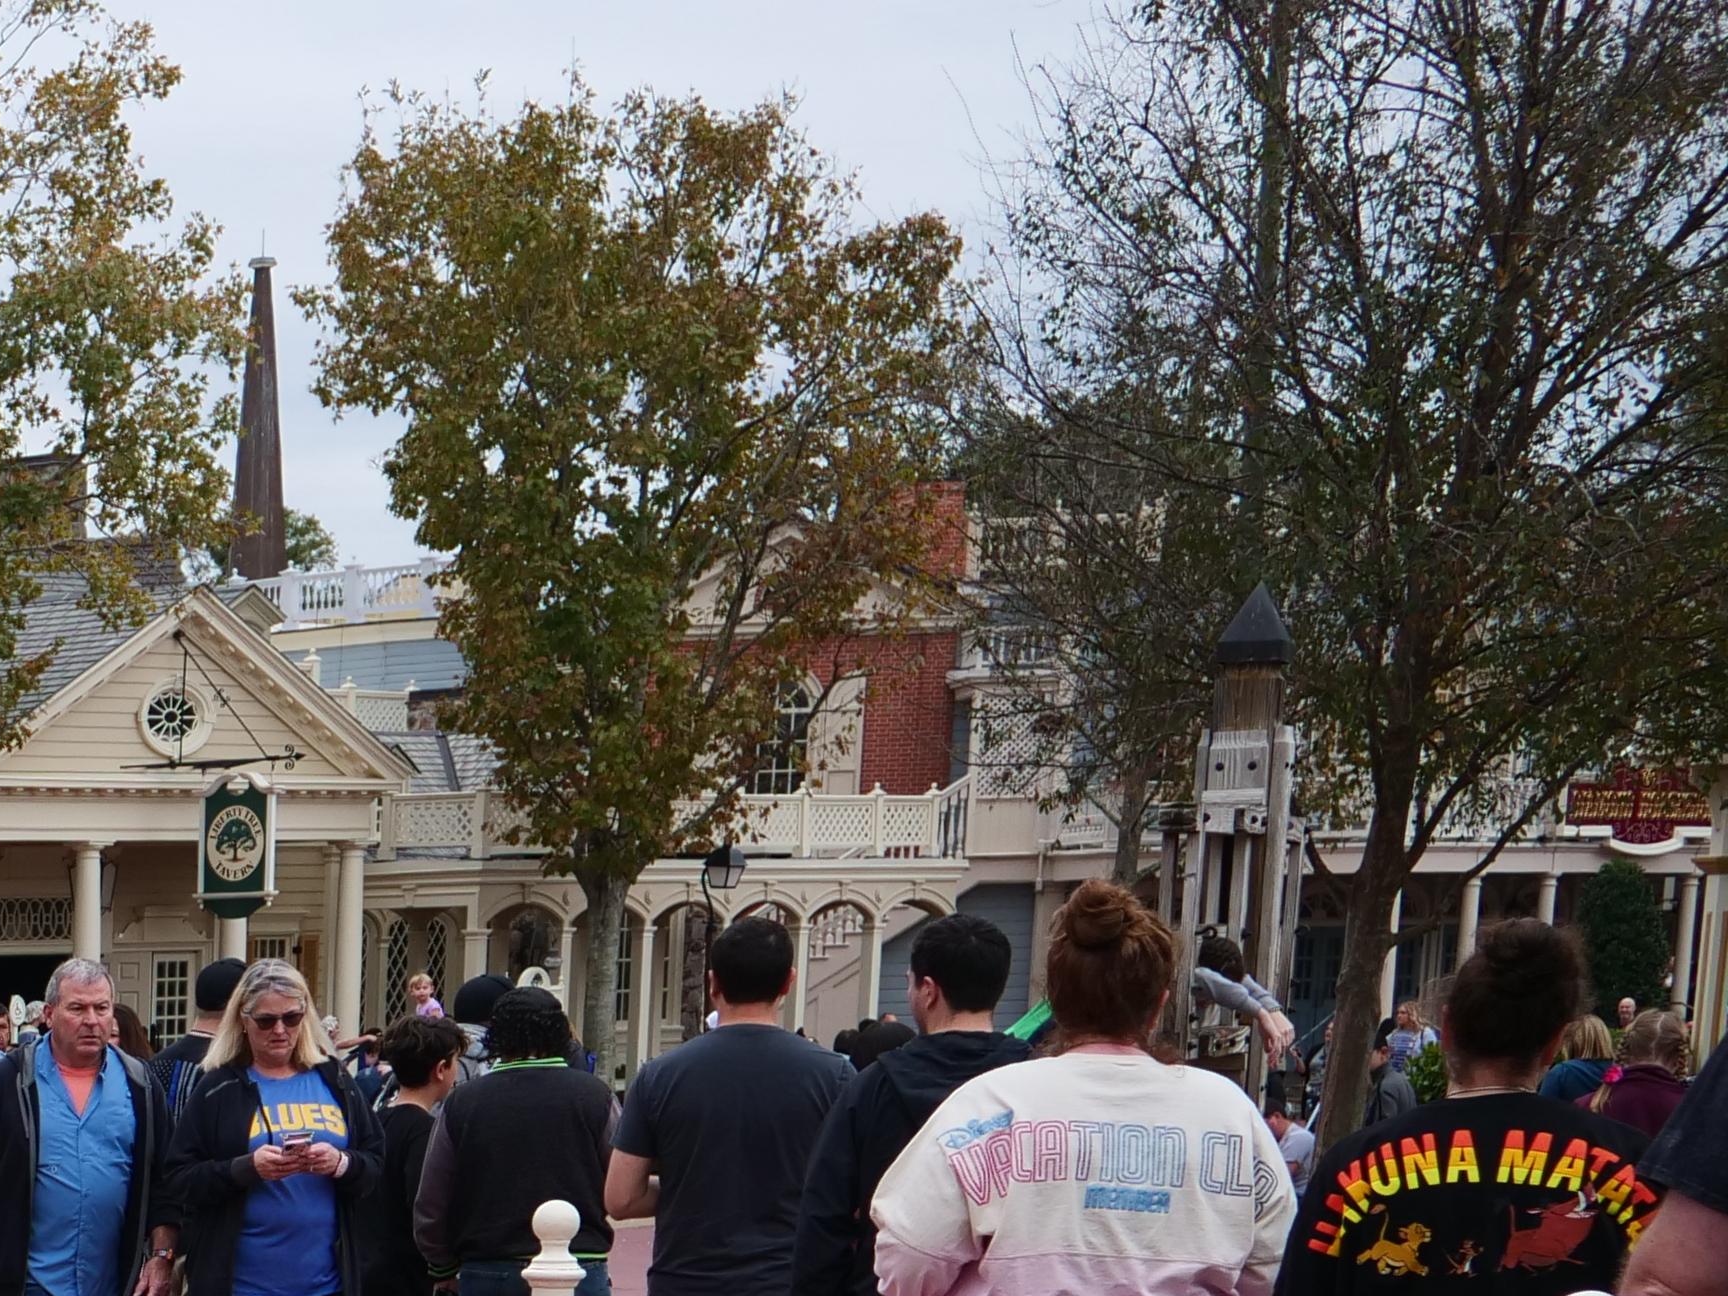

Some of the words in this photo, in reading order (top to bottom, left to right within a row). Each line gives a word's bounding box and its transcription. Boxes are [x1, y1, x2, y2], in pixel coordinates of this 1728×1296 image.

[209, 806, 244, 840] LIBERTY
[244, 810, 263, 838] TREE
[214, 860, 255, 880] TAVERN
